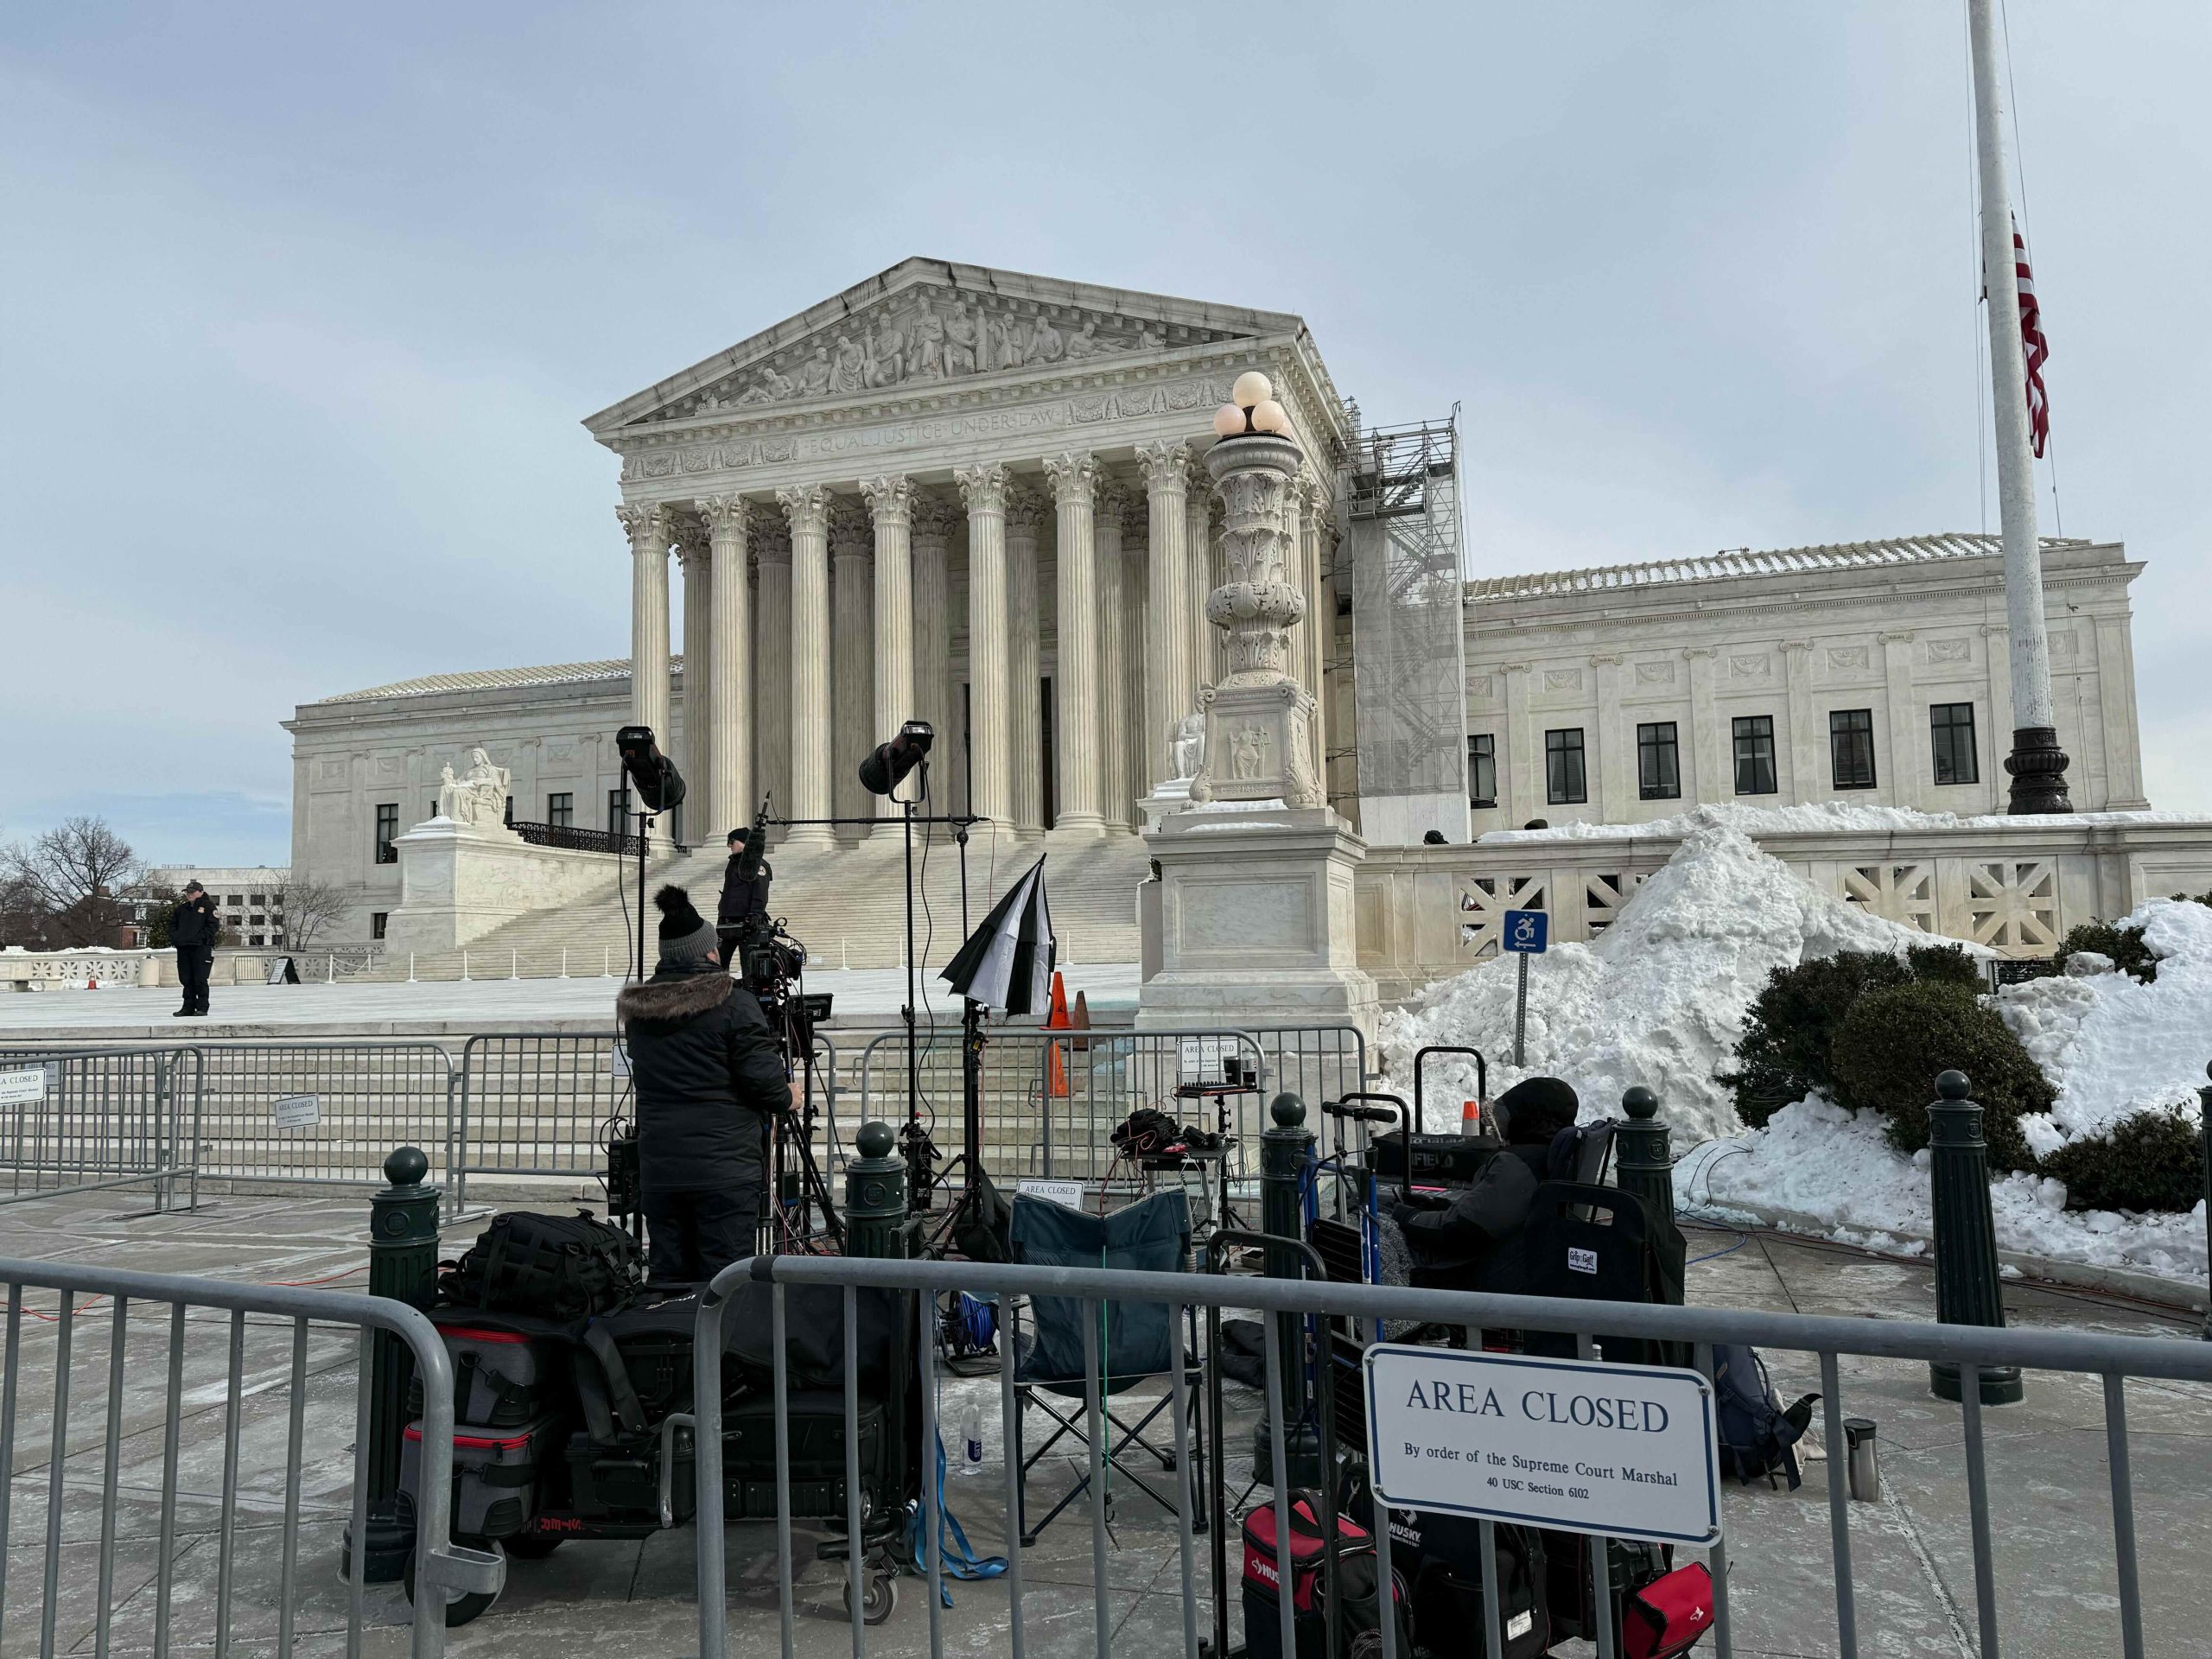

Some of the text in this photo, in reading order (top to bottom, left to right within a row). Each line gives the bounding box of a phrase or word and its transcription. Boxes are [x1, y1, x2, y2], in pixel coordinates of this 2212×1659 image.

[810, 410, 1054, 454] EQUAL JUSTICE UNDER LAW
[10, 1075, 38, 1084] CLOSED
[291, 1100, 313, 1109] CLOSED
[1047, 1186, 1076, 1195] CLOSED
[1406, 1379, 1669, 1433] AREA CLOSED
[1404, 1442, 1677, 1486] By order of the Supreme Court Marshal
[1487, 1477, 1589, 1499] 40 USC Section 6102
[1389, 1521, 1422, 1542] HUSKY
[1262, 1564, 1280, 1583] HUS
